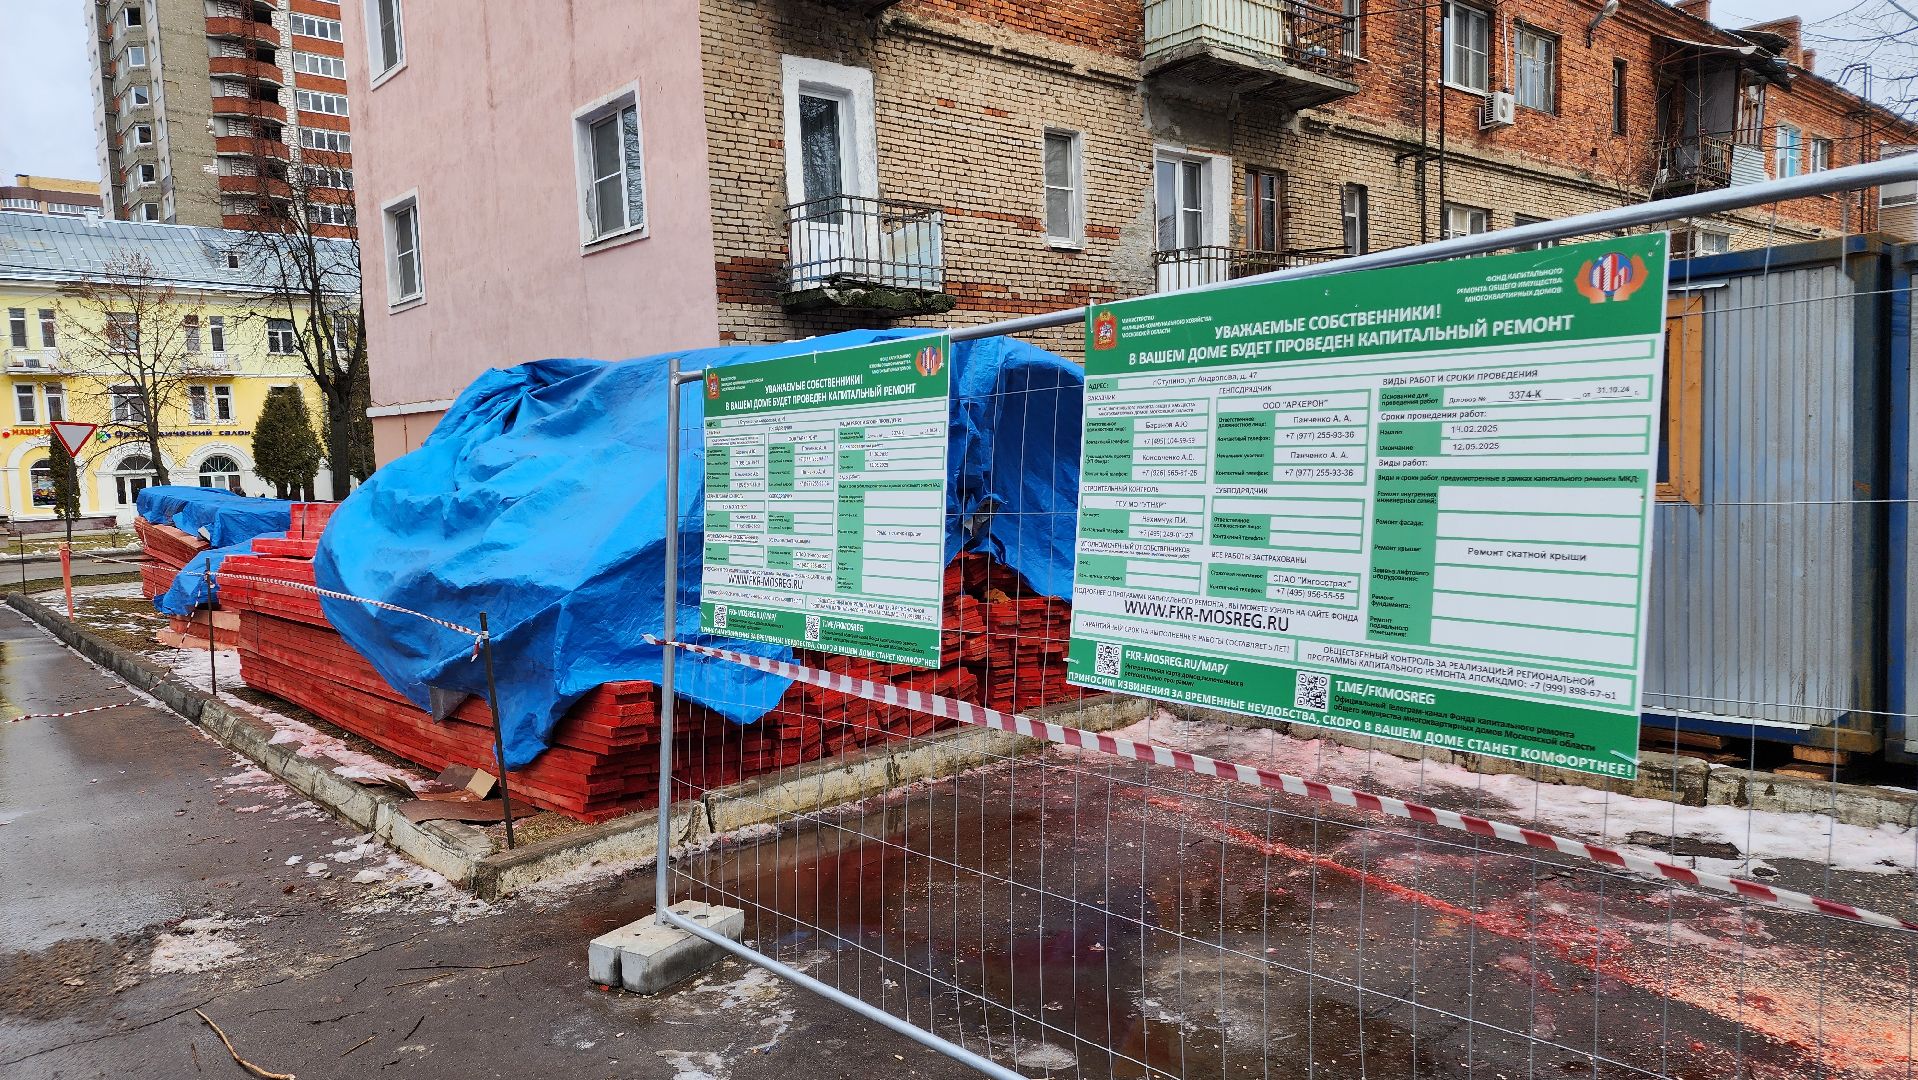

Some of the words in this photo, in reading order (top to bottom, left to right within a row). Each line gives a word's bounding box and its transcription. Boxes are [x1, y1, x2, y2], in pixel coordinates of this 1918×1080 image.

[1486, 273, 1506, 283] ФОНД
[1507, 267, 1563, 280] КАПИТАЛЬНОГО
[1456, 285, 1486, 295] РЕМОНТА
[1488, 281, 1516, 291] ОБЩЕГО
[1518, 276, 1562, 288] ИМУЩЕСТВА
[1464, 289, 1533, 303] МНОГОКВАРТИРНЫХ
[1533, 286, 1561, 296] ДОМОВ
[1214, 317, 1305, 339] УВАЖАЕМЫЕ
[1308, 303, 1441, 330] СОБСТВЕННИКИ!
[1128, 352, 1135, 365] В
[1139, 348, 1184, 364] ВАШЕМ
[1187, 344, 1226, 363] ДОМЕ
[1230, 340, 1272, 359] БУДЕТ
[1275, 333, 1354, 356] ПРОВЕДЕН
[1357, 317, 1487, 346] КАПИТАЛЬНЫЙ
[1492, 313, 1574, 336] РЕМОНТ
[764, 380, 805, 394] УВАЖАЕМЫЕ
[806, 373, 862, 390] СОБСТВЕННИКИ!
[1382, 377, 1406, 386] ВИДЫ
[1408, 375, 1435, 384] РАБОТ
[1446, 373, 1474, 382] СРОКИ
[1477, 369, 1538, 381] ПРОВЕДЕНИЯ
[1088, 382, 1108, 390] АДРЕС:
[1218, 385, 1271, 394] ГЕНПОДРЯДЧИК
[725, 402, 729, 410] В
[730, 399, 751, 410] ВАШЕМ
[772, 395, 792, 408] БУДЕТ
[792, 392, 826, 406] ПРОВЕДЕН
[828, 384, 881, 401] КАПИТАЛЬНЫЙ
[883, 382, 915, 396] РЕМОНТ
[1381, 392, 1415, 400] Основание
[1418, 397, 1438, 405] работ
[1262, 401, 1280, 409] ООО
[1380, 413, 1404, 422] Сроки
[1406, 412, 1456, 421] проведения
[1459, 409, 1486, 420] работ:
[1296, 432, 1314, 441] (977)
[1378, 459, 1399, 467] Виды
[1401, 458, 1428, 468] работ:
[1295, 469, 1313, 477] (977)
[1084, 484, 1127, 492] СТРОИТЕЛЬНЫЙ
[1215, 486, 1268, 494] СУБПОДРЯДЧИК
[1252, 554, 1306, 564] ЗАСТРАХОВАНЫ
[1467, 547, 1503, 557] Ремонт
[1506, 548, 1546, 559] скатной
[1548, 552, 1586, 562] крыши
[1273, 574, 1295, 583] СПАО
[1124, 600, 1288, 631] WWW.FKR-MOSREG.RU
[1239, 603, 1267, 612] МОЖЕТЕ
[1269, 606, 1294, 615] УЗНАТЬ
[1307, 608, 1329, 618] САЙТЕ
[1331, 612, 1357, 622] ФОНДА
[876, 651, 895, 662] СТАНЕТ
[1125, 649, 1228, 676] FKR-MOSREG.RU/MAP/
[1323, 644, 1388, 662] ОБЩЕСТВЕННЫЙ
[1390, 654, 1434, 667] КОНТРОЛЬ
[1435, 660, 1446, 668] ЗА
[1448, 660, 1514, 678] РЕАЛИЗАЦИЕЙ
[1516, 667, 1594, 687] РЕГИОНАЛЬНОЙ
[1307, 653, 1356, 666] ПРОГРАММЫ
[1358, 659, 1422, 674] КАПИТАЛЬНОГО
[1425, 668, 1466, 680] РЕМОНТА
[1541, 682, 1567, 695] (999)
[1335, 680, 1435, 706] T.ME/FKMOSREG
[1068, 671, 1114, 687] ПРИНОСИМ
[1117, 679, 1169, 696] ИЗВИНЕНИЯ
[1171, 688, 1182, 698] ЗА
[1184, 691, 1244, 709] ВРЕМЕННЫЕ
[1247, 701, 1320, 724] НЕУДОБСТВА,
[1322, 714, 1360, 729] СКОРО
[1364, 721, 1371, 731] В
[1374, 722, 1422, 740] ВАШЕМ
[1424, 730, 1466, 749] ДОМЕ
[1468, 738, 1517, 756] СТАНЕТ
[1520, 746, 1632, 777] КОМФОРТНЕЕ!
[1334, 694, 1386, 710] Официальный
[1388, 702, 1447, 719] Телеграм-канал
[1449, 712, 1475, 724] Фонда
[1477, 716, 1534, 732] капитального
[1536, 726, 1575, 740] ремонта
[1333, 703, 1359, 715] общего
[1360, 708, 1401, 722] имущества
[1402, 714, 1473, 733] многоквартирных
[1474, 726, 1503, 738] домов
[1504, 729, 1558, 746] Московской
[1559, 738, 1595, 752] области
